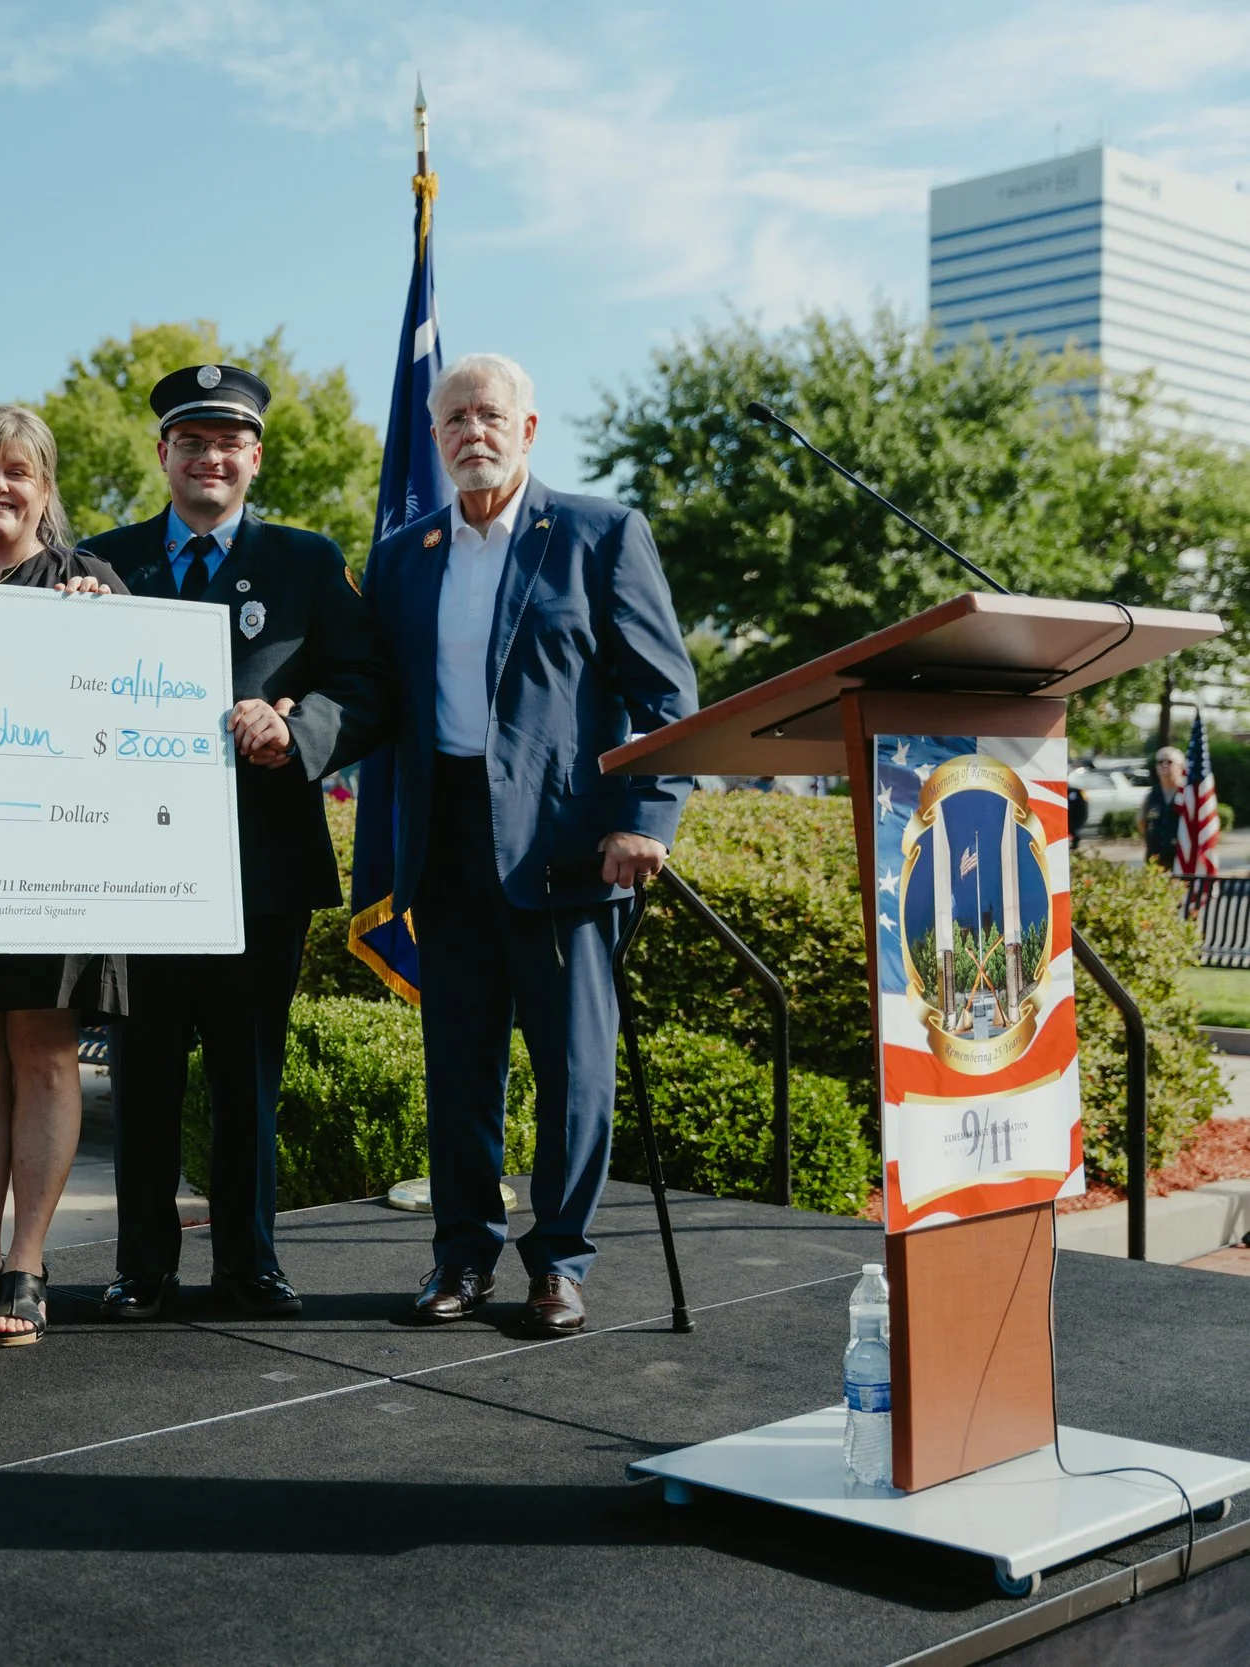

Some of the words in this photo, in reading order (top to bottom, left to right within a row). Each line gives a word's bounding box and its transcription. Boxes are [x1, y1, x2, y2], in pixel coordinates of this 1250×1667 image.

[69, 674, 108, 692] Date:
[93, 729, 108, 758] $
[929, 771, 959, 799] Morning
[961, 761, 971, 783] of
[49, 804, 110, 823] Dollars
[18, 879, 100, 893] Remembrance
[102, 880, 167, 894] Foundation
[169, 881, 182, 898] of
[182, 882, 197, 894] SC
[43, 905, 87, 919] Signature
[944, 1042, 992, 1065] Remembering
[993, 1046, 1002, 1060] 25
[1004, 1034, 1022, 1054] Years
[943, 1127, 989, 1143] REMEMBRANCE
[990, 1121, 1028, 1136] FOUNDATION
[961, 1107, 1012, 1172] 9/11
